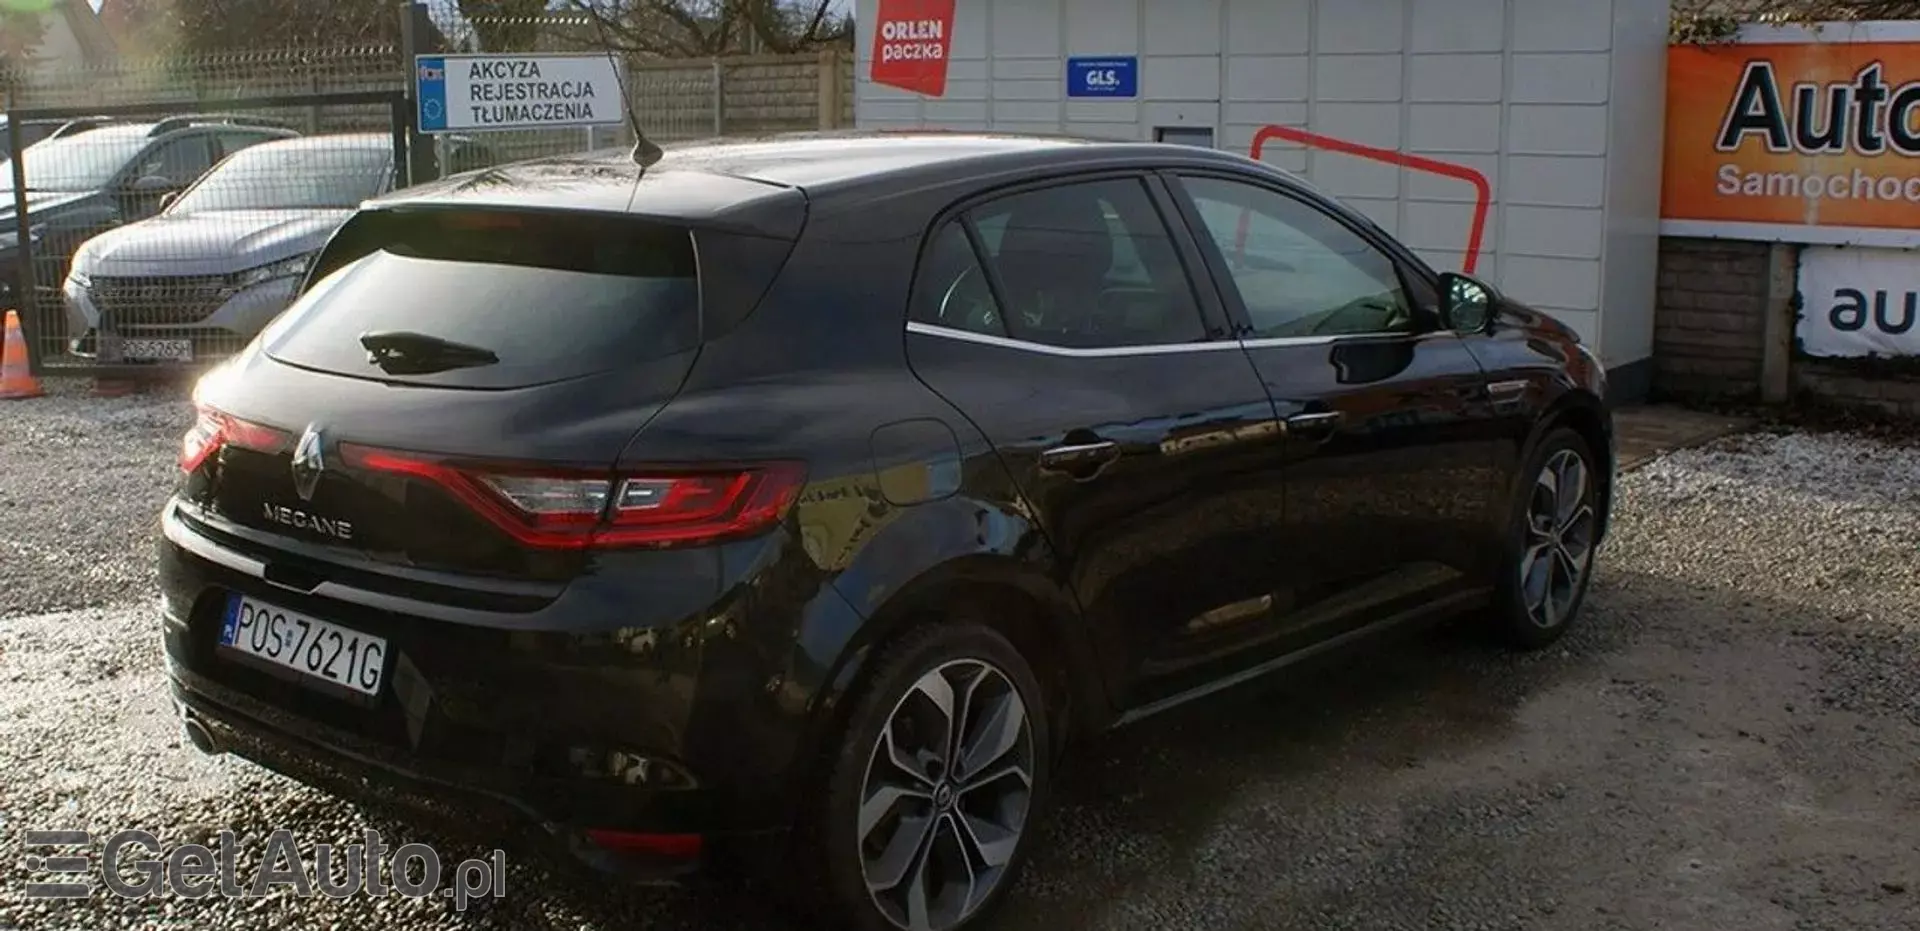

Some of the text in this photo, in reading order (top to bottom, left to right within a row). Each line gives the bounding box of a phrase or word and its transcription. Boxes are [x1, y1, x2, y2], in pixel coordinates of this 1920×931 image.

[882, 19, 943, 40] ORLEN
[882, 42, 943, 65] paczka
[469, 61, 541, 79] AKCYZA
[470, 81, 595, 101] REJESTRACJA
[471, 103, 594, 123] TŁUMACZENIA
[1715, 61, 1920, 155] Auto
[262, 501, 353, 540] MEGANE
[237, 601, 382, 690] POS 7621G
